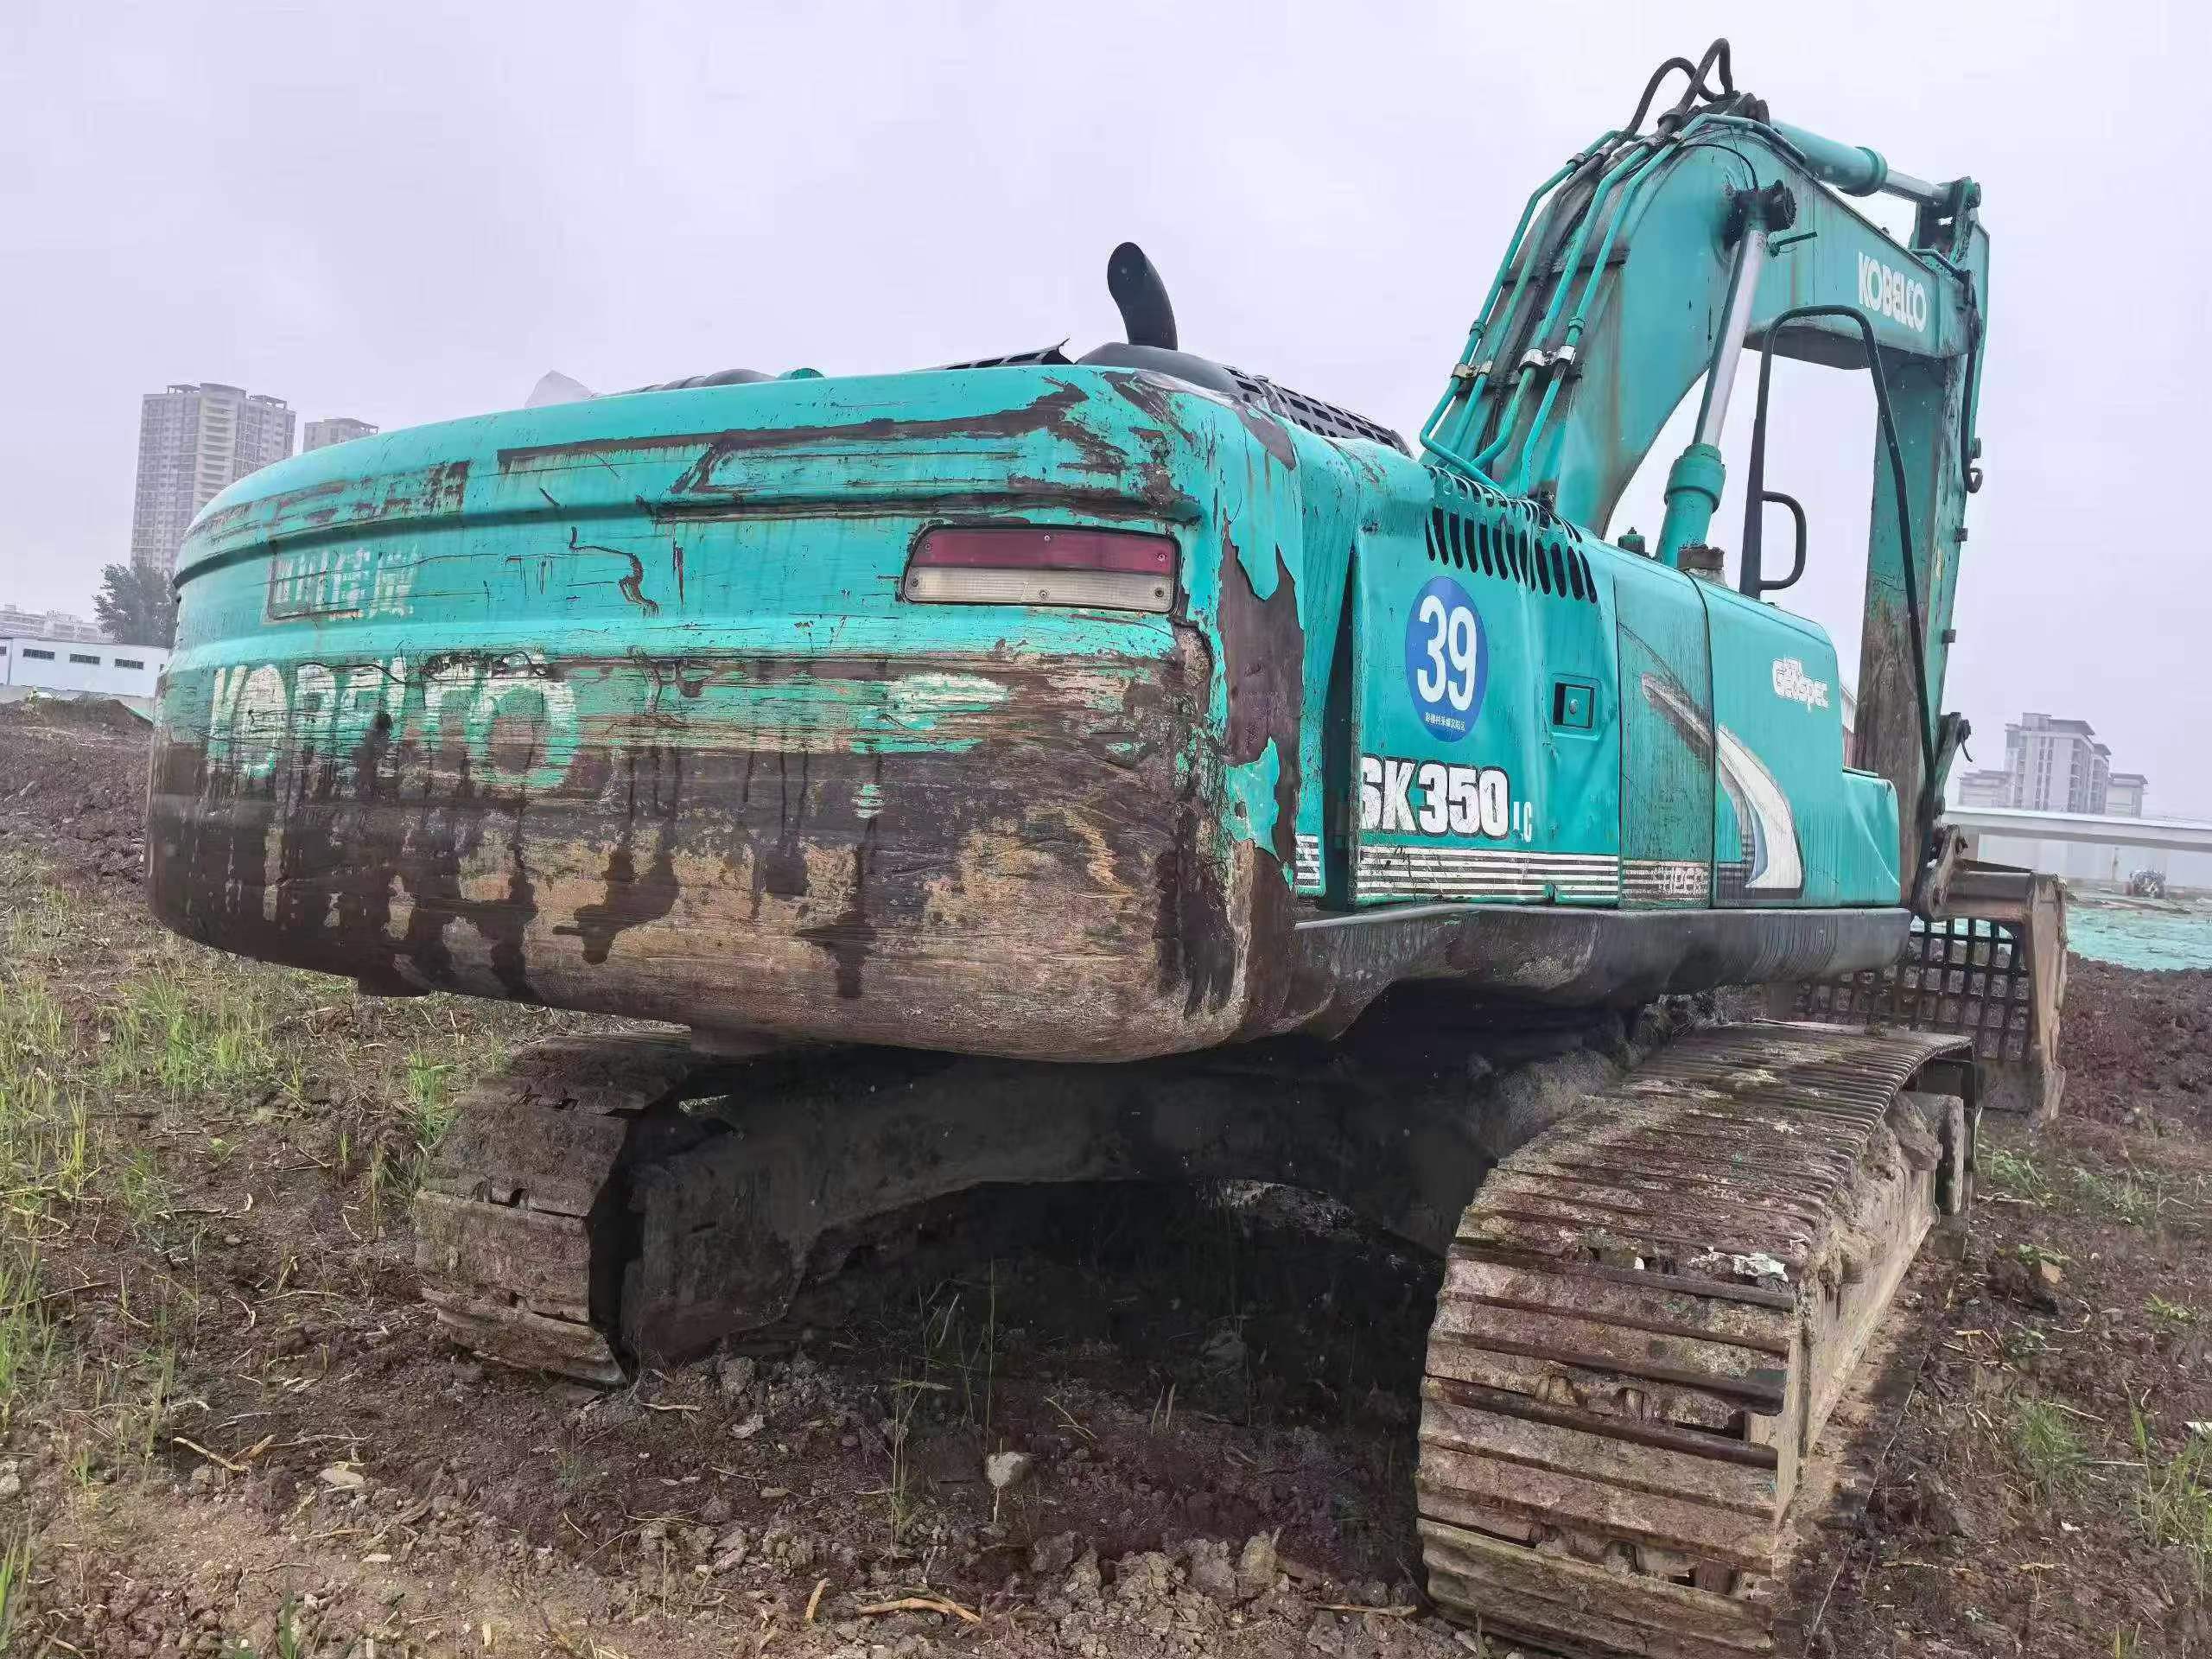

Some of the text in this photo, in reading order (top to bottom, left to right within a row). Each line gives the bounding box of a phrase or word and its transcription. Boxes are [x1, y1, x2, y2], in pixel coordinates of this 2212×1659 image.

[1859, 251, 1927, 333] KOBELCO
[1417, 594, 1478, 711] 39
[1360, 753, 1510, 840] SK350
